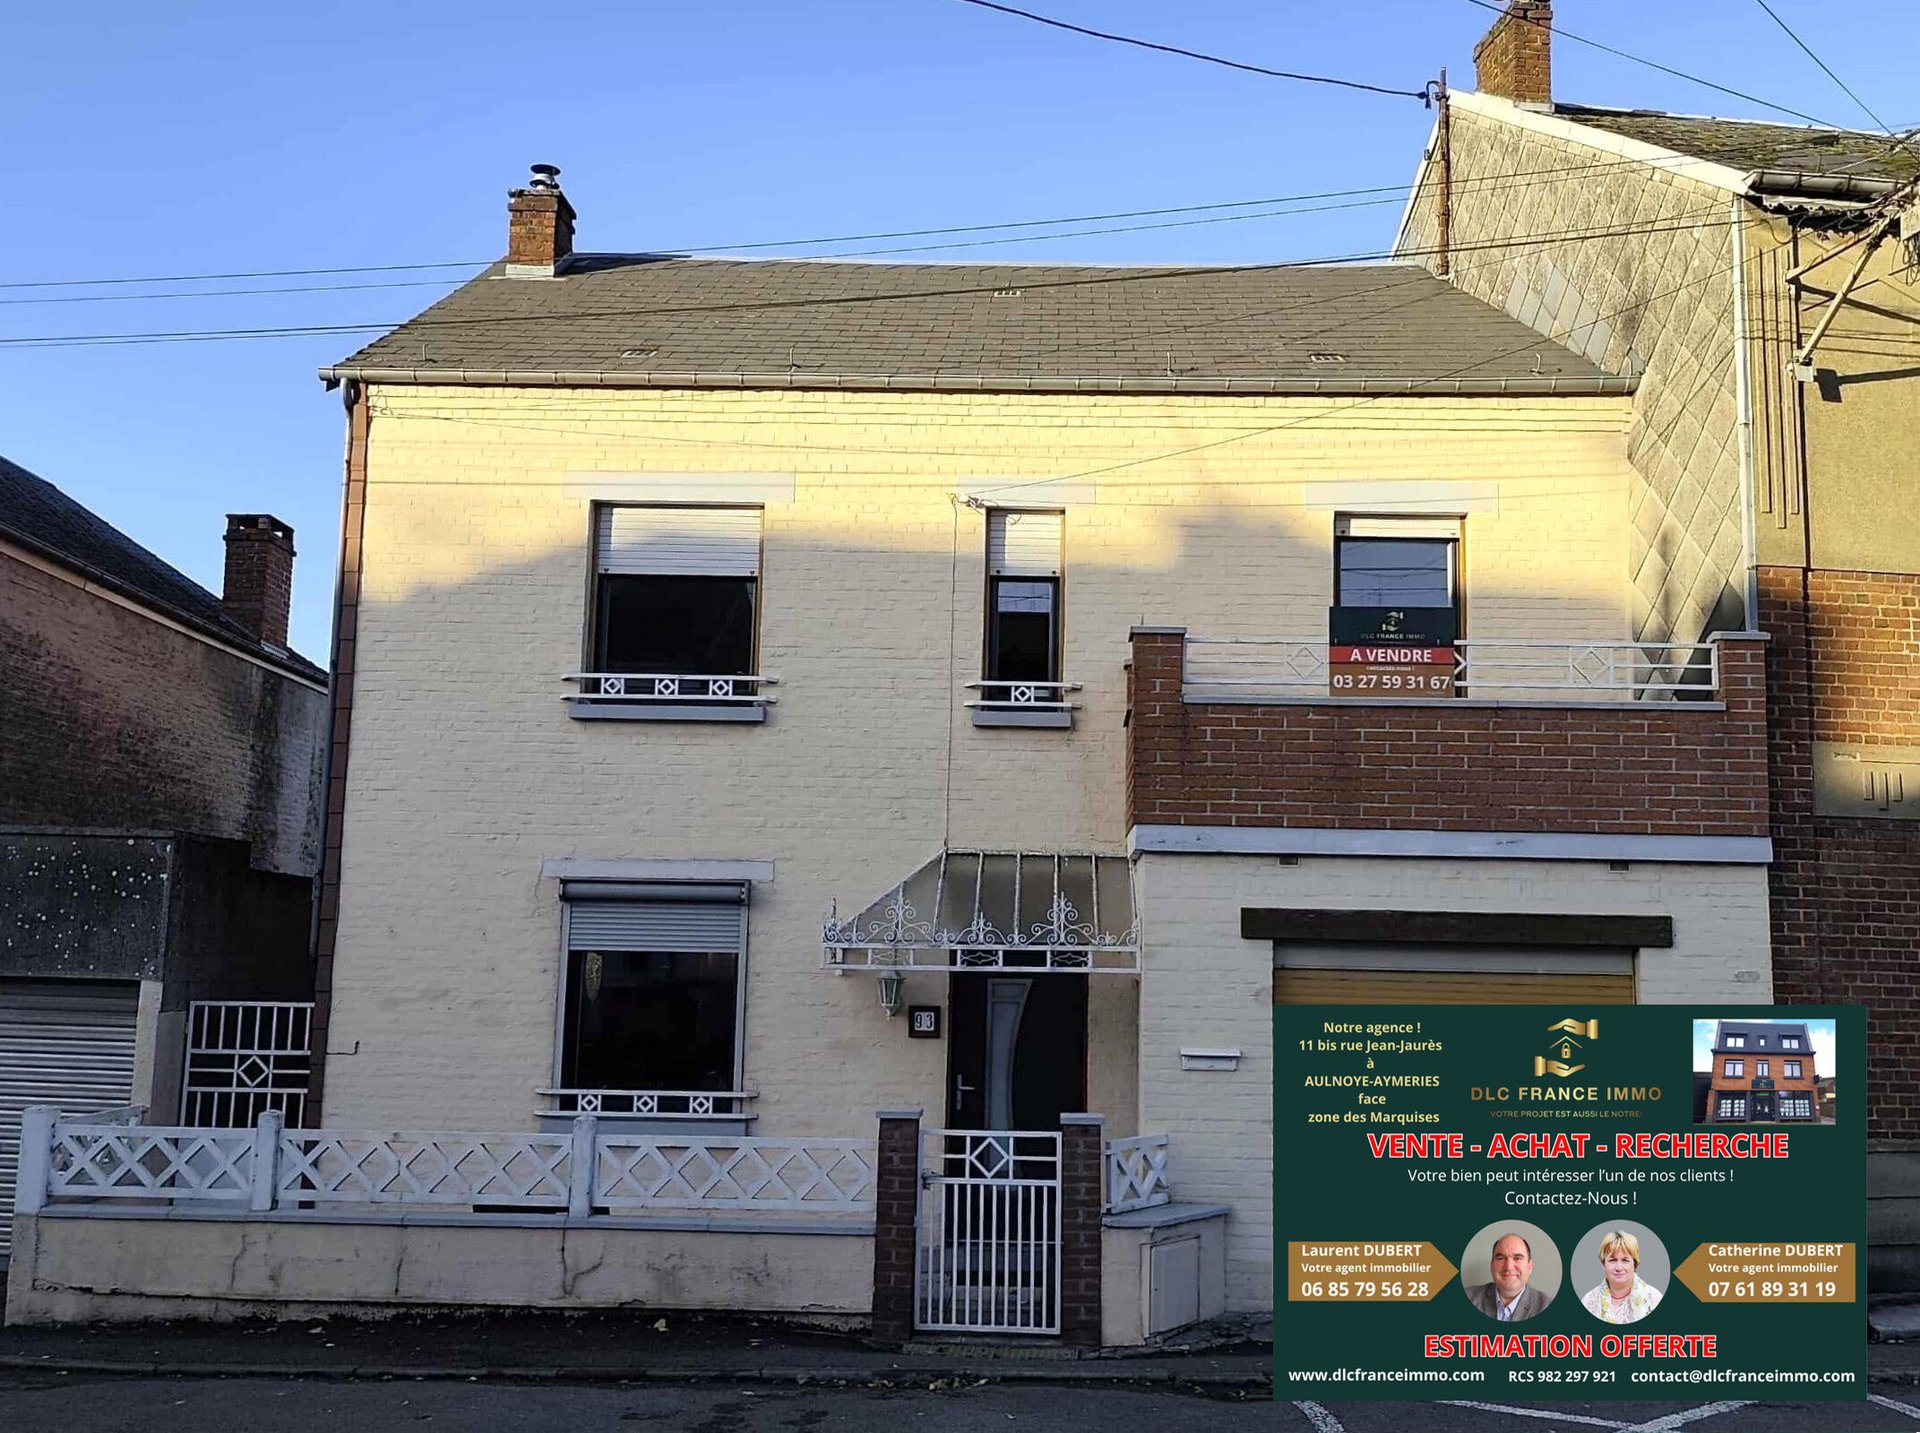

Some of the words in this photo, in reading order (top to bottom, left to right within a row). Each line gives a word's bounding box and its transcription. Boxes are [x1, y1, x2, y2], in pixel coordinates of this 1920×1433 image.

[1350, 648, 1362, 662] A
[1365, 648, 1432, 662] VENDRE
[1333, 674, 1353, 688] 03
[1357, 674, 1377, 688] 27
[1381, 675, 1401, 689] 59
[1406, 675, 1424, 689] 31
[1430, 675, 1450, 689] 67
[915, 1013, 933, 1029] 93
